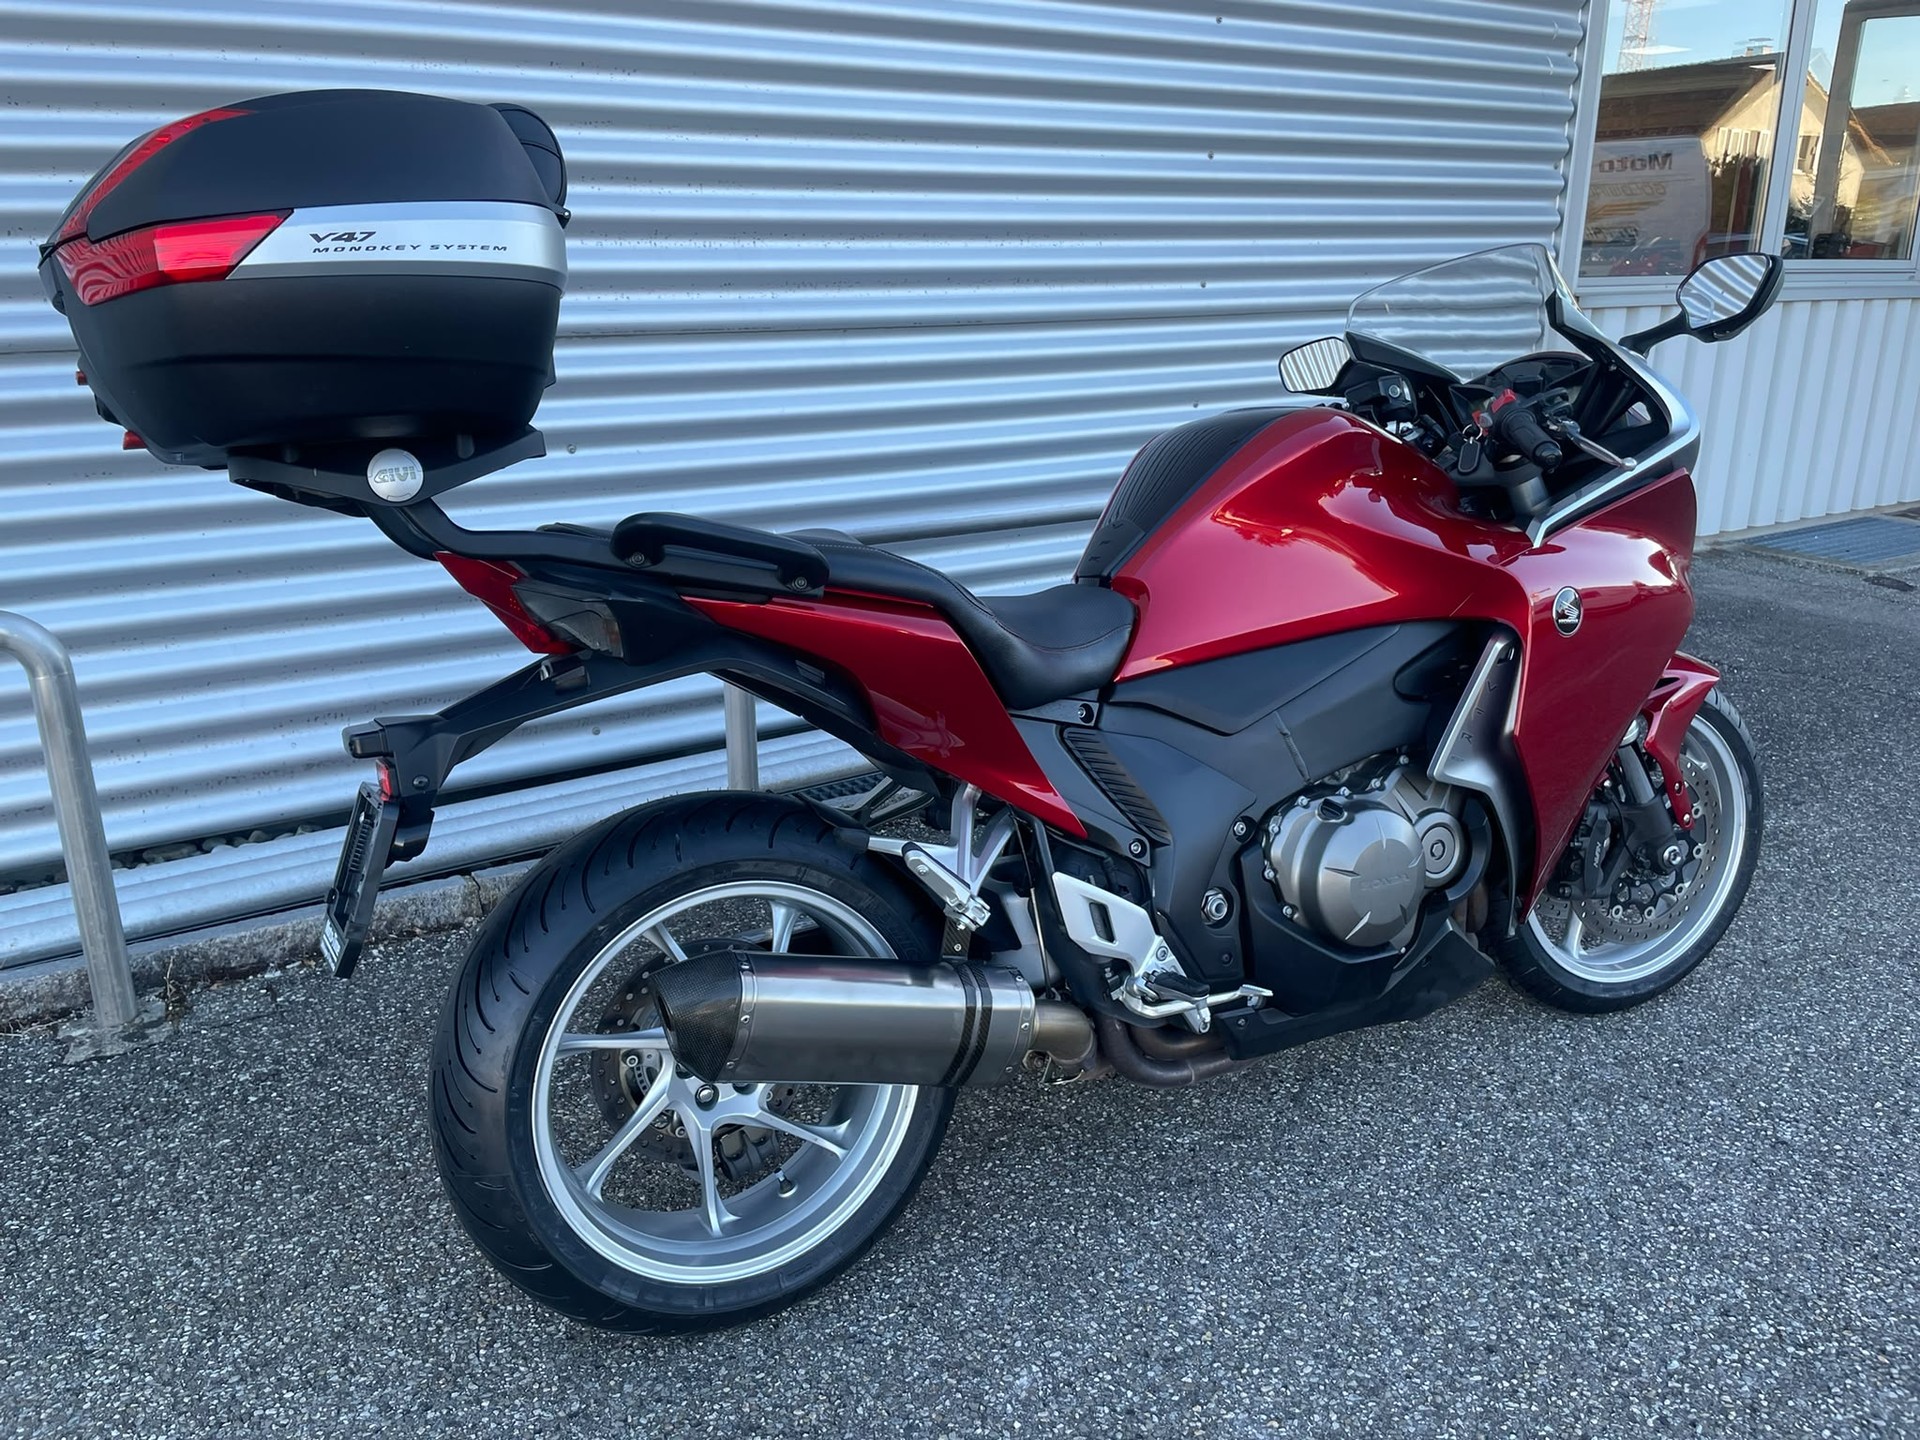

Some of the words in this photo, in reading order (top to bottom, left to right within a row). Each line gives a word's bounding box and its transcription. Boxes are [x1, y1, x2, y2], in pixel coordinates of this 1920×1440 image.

[309, 231, 376, 243] V47
[312, 244, 421, 253] MONOKEY
[374, 466, 416, 483] GIVI
